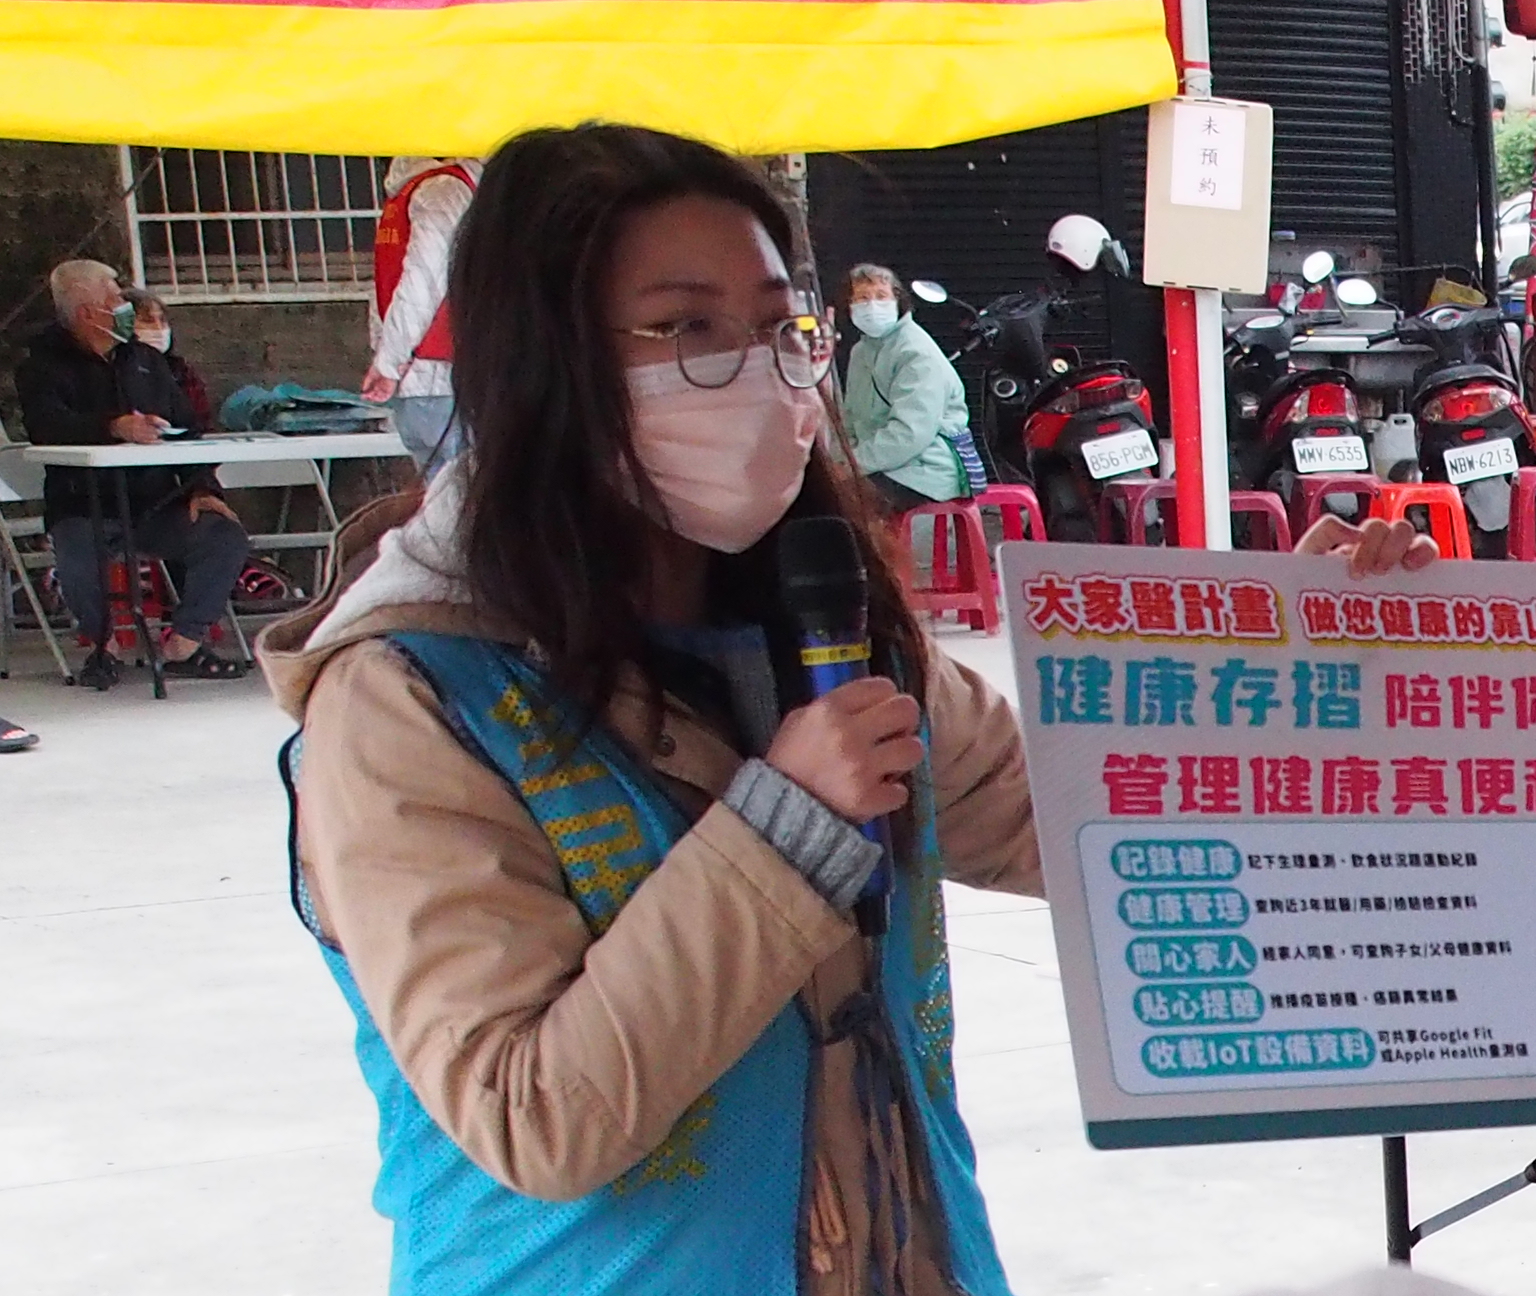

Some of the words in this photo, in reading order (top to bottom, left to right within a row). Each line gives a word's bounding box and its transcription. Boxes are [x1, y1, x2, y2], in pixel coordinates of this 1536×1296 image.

[1198, 115, 1220, 197] 未預約
[1027, 576, 1280, 637] 大家醫計畫
[1036, 655, 1362, 730] 健康存摺
[1116, 846, 1237, 877] 記錄健康
[1124, 892, 1246, 925] 健康管理
[1133, 940, 1252, 974] 關心家人
[1139, 988, 1261, 1022] 貼心提醒
[1148, 1031, 1369, 1071] 收載IoT設備資料
